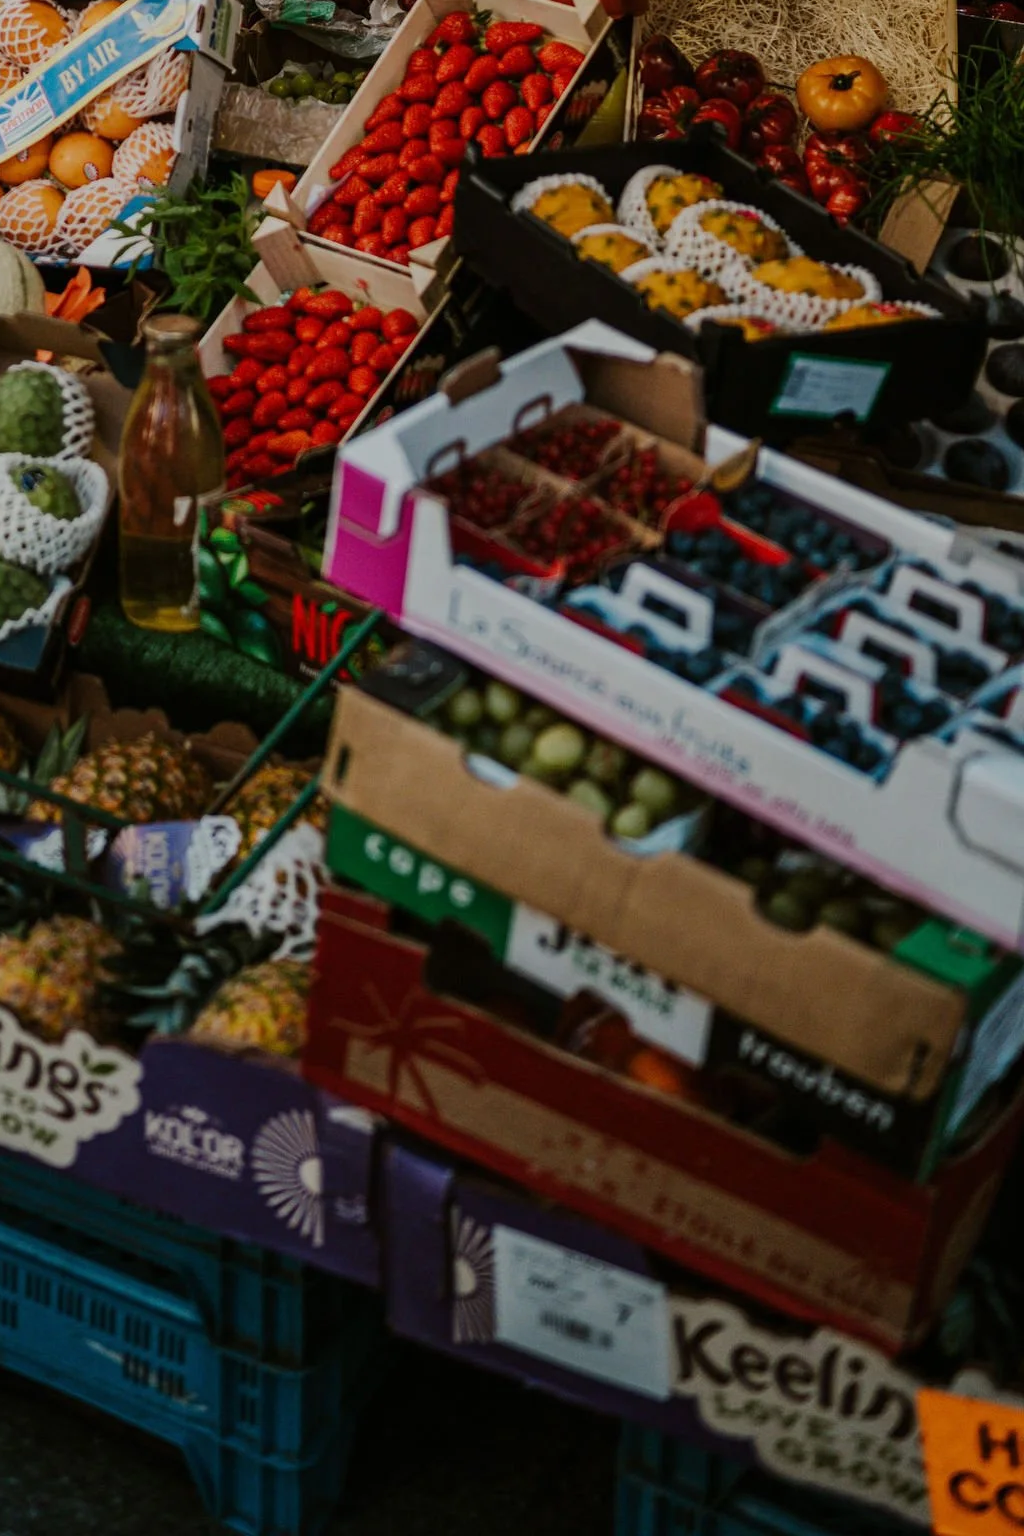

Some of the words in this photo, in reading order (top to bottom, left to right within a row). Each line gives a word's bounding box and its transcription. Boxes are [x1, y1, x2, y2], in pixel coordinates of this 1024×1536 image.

[58, 59, 87, 95] BY
[88, 37, 122, 80] AIR
[363, 831, 477, 909] cape
[0, 1087, 38, 1112] TO
[737, 1028, 897, 1133] trauben
[674, 1314, 914, 1440] Keelin
[713, 1393, 828, 1438] LOVE
[775, 1437, 928, 1504] GROW
